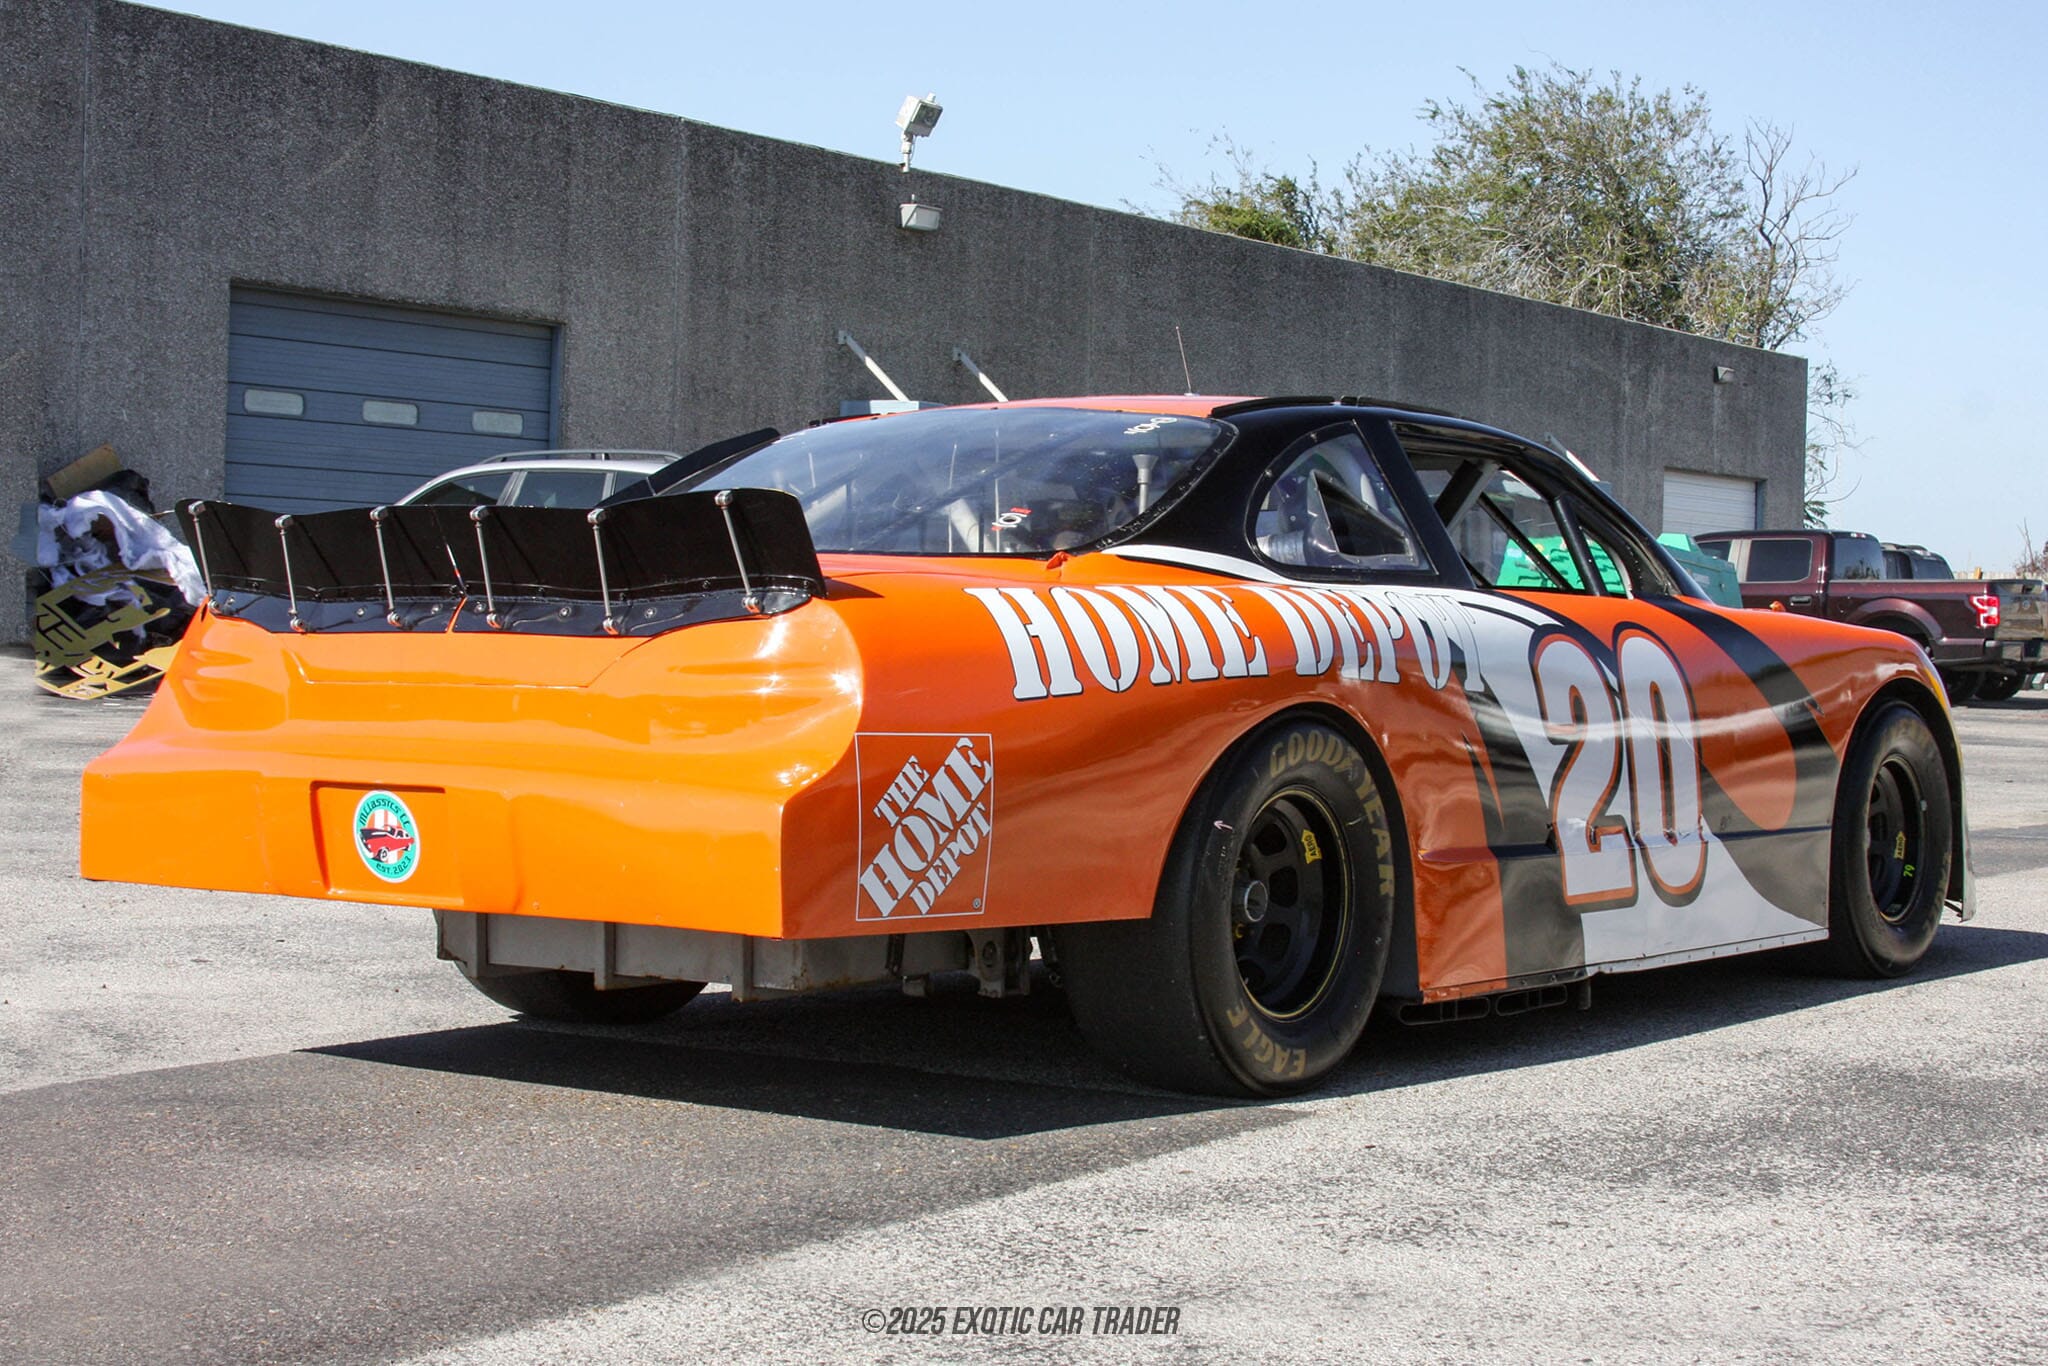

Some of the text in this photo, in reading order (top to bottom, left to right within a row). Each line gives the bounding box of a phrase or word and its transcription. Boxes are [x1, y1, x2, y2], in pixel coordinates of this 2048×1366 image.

[963, 586, 1486, 701] HOME DEPOT
[872, 755, 930, 828] THE
[1270, 730, 1394, 898] GOODYEAR
[1529, 622, 1707, 907] 20
[859, 737, 992, 918] HOME
[909, 801, 991, 916] DEPOT
[1226, 998, 1307, 1078] EAGLE
